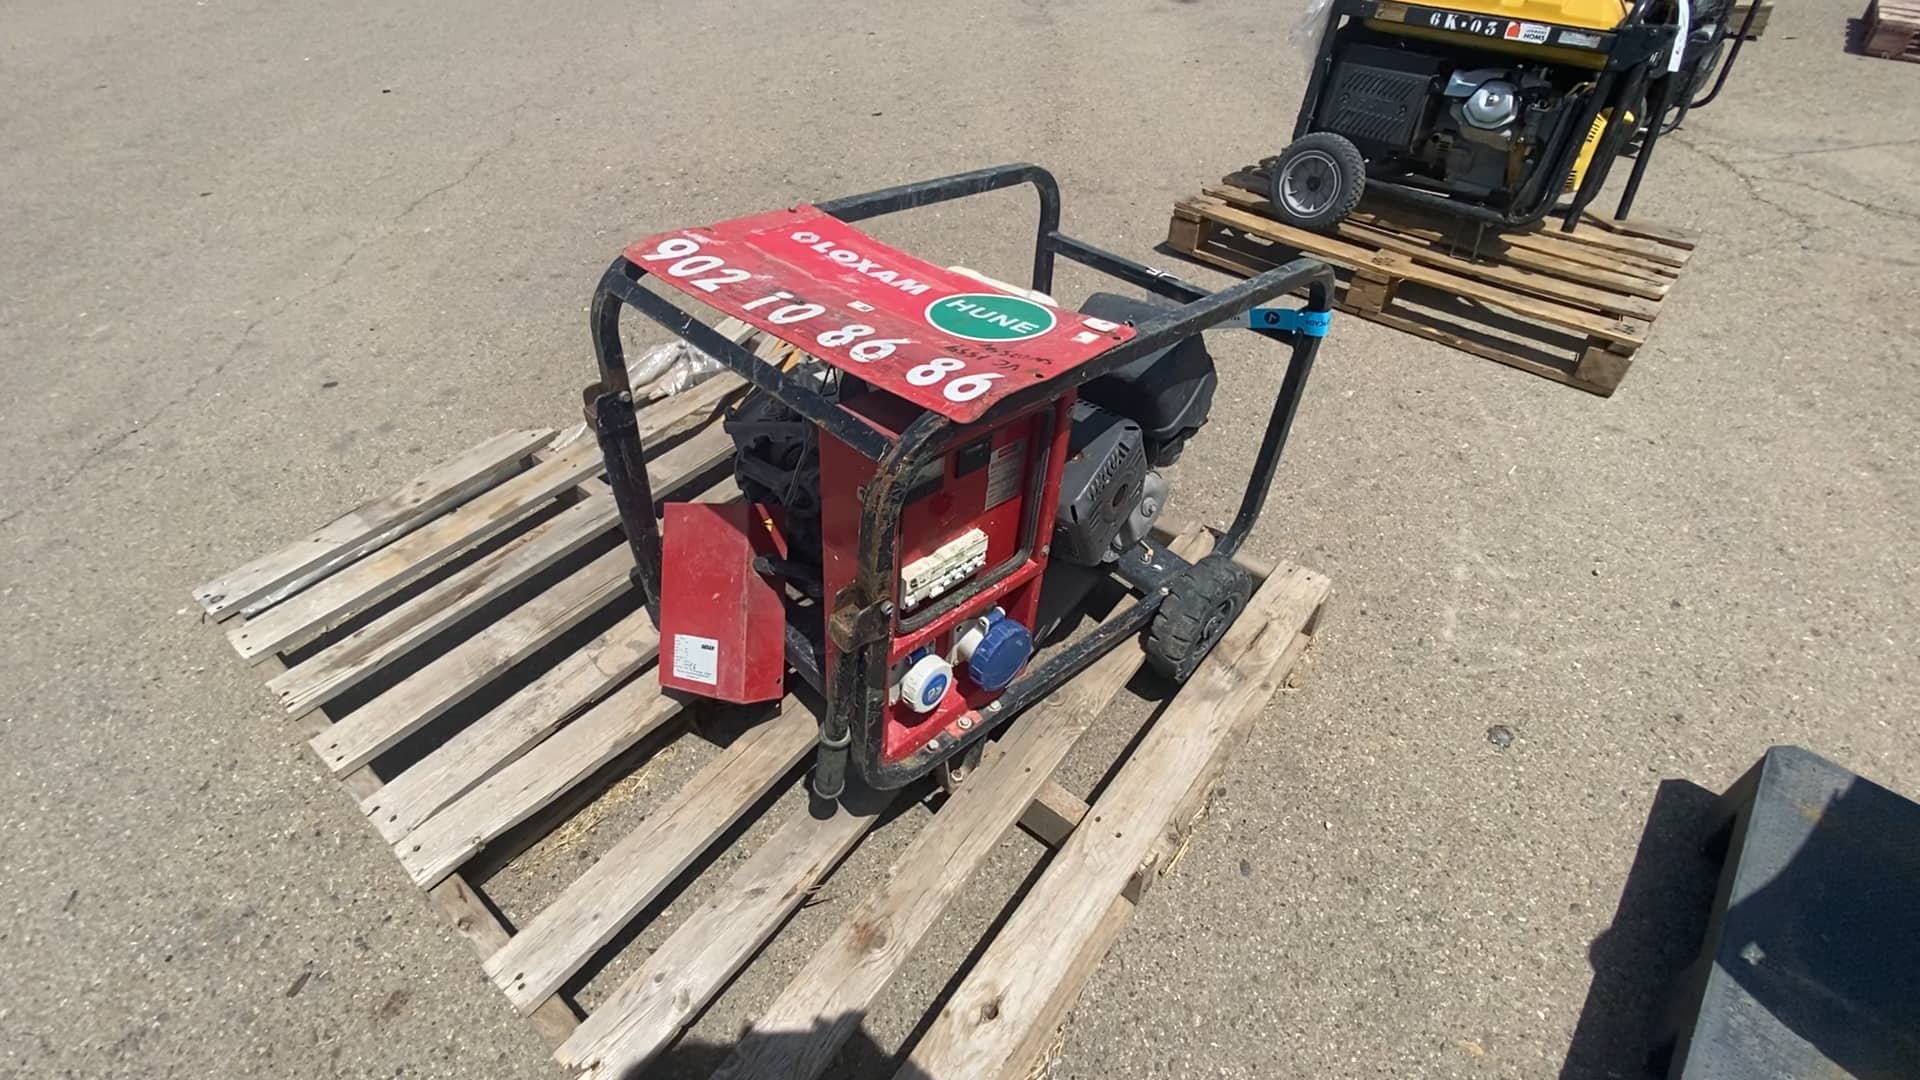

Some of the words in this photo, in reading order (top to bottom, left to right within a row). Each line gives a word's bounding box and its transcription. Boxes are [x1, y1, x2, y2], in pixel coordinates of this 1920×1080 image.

[810, 241, 931, 295] LOXAM
[641, 238, 750, 293] 902
[741, 291, 826, 324] 10
[817, 324, 912, 363] 86
[906, 358, 1005, 402] 86
[945, 299, 1040, 334] HUNE
